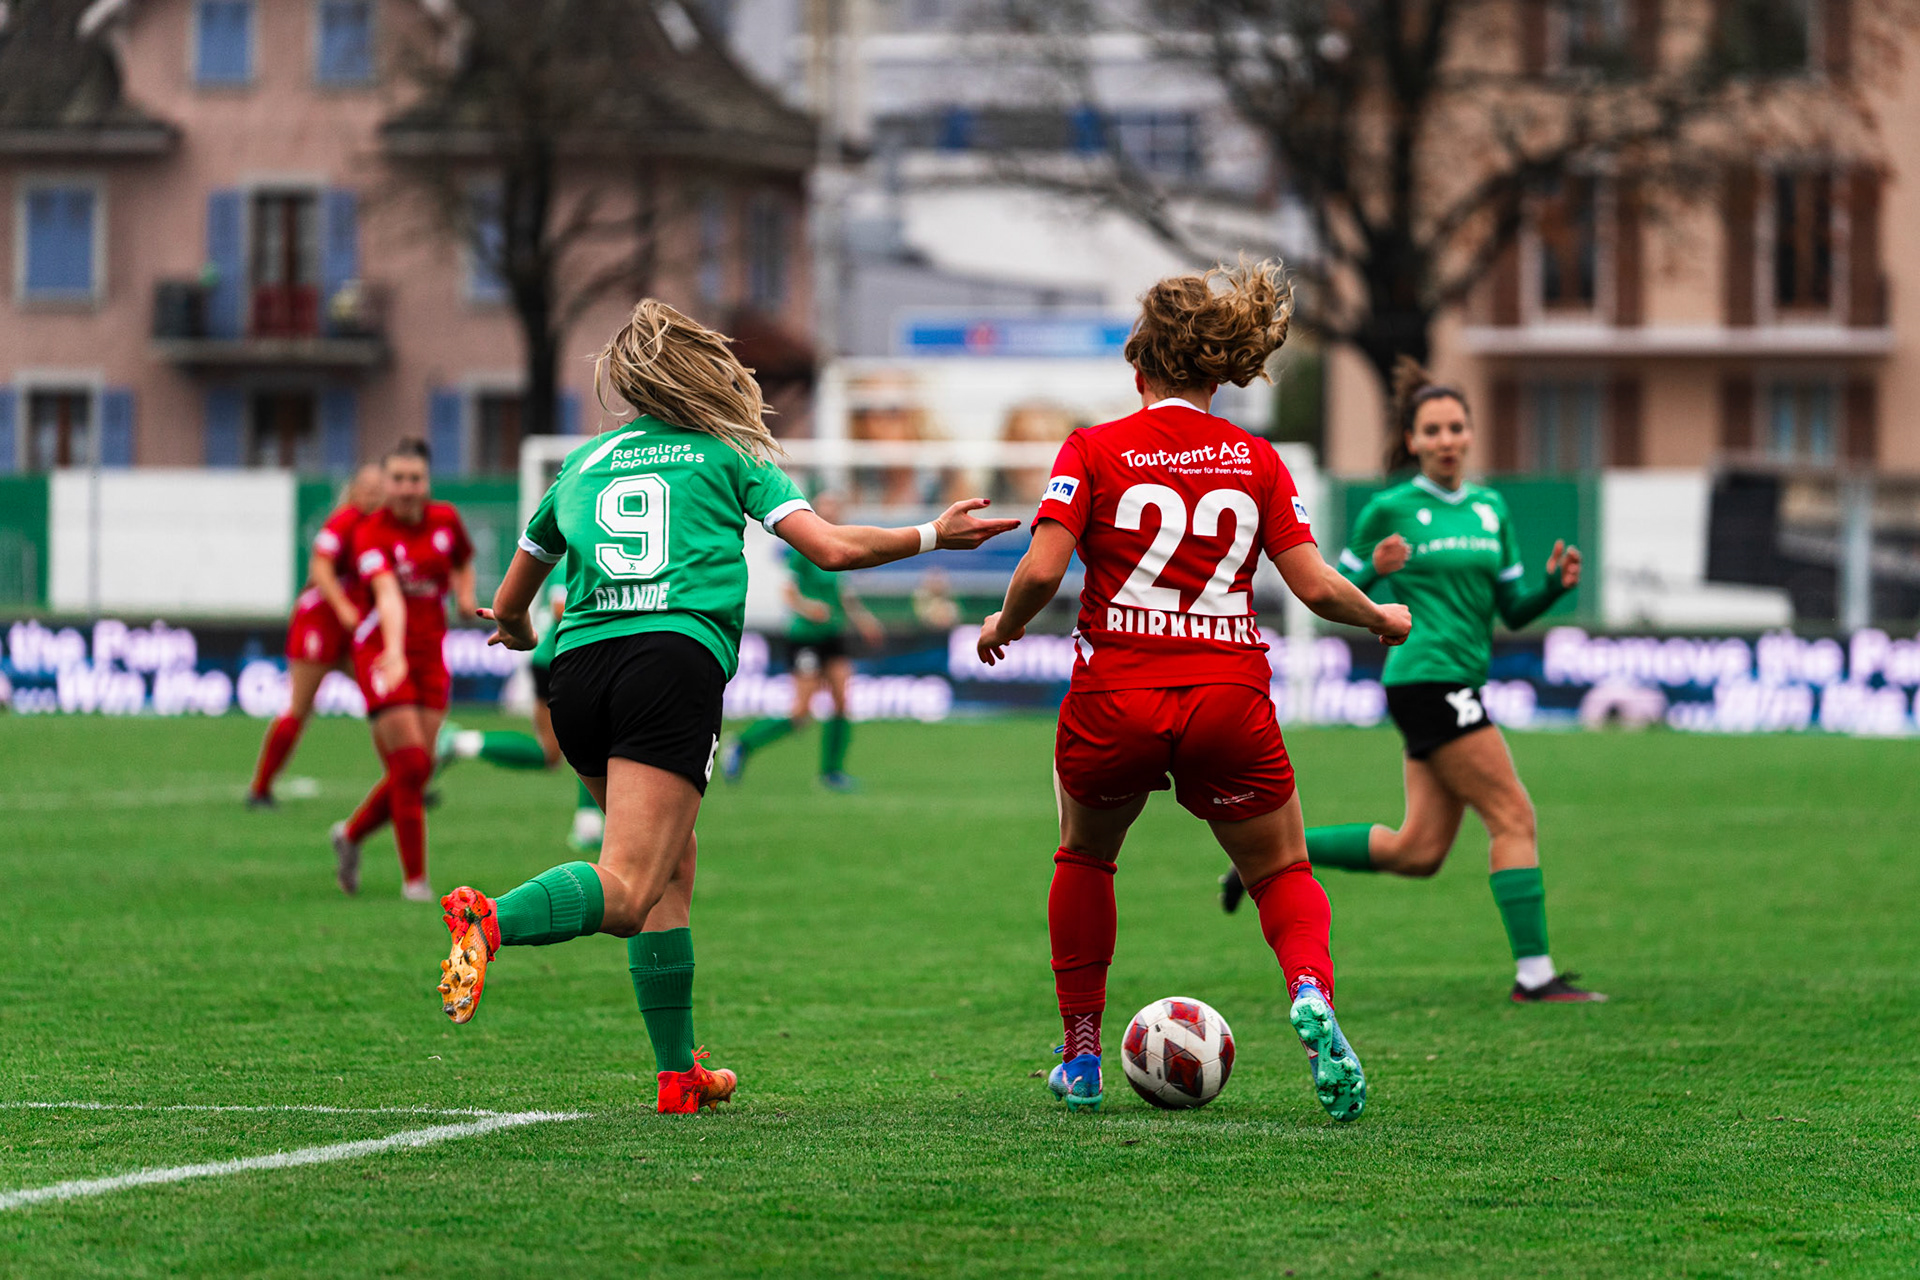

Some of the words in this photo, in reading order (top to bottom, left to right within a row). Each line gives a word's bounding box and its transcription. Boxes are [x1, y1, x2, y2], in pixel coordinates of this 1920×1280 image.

[610, 453, 705, 471] Populaires
[612, 443, 691, 461] Retraites
[1121, 445, 1216, 467] Toutvent
[1218, 441, 1250, 460] AG
[1179, 467, 1202, 475] Partner
[1204, 466, 1213, 474] für
[595, 473, 670, 579] 9
[1110, 483, 1260, 616] 22
[595, 582, 670, 611] GRANDE
